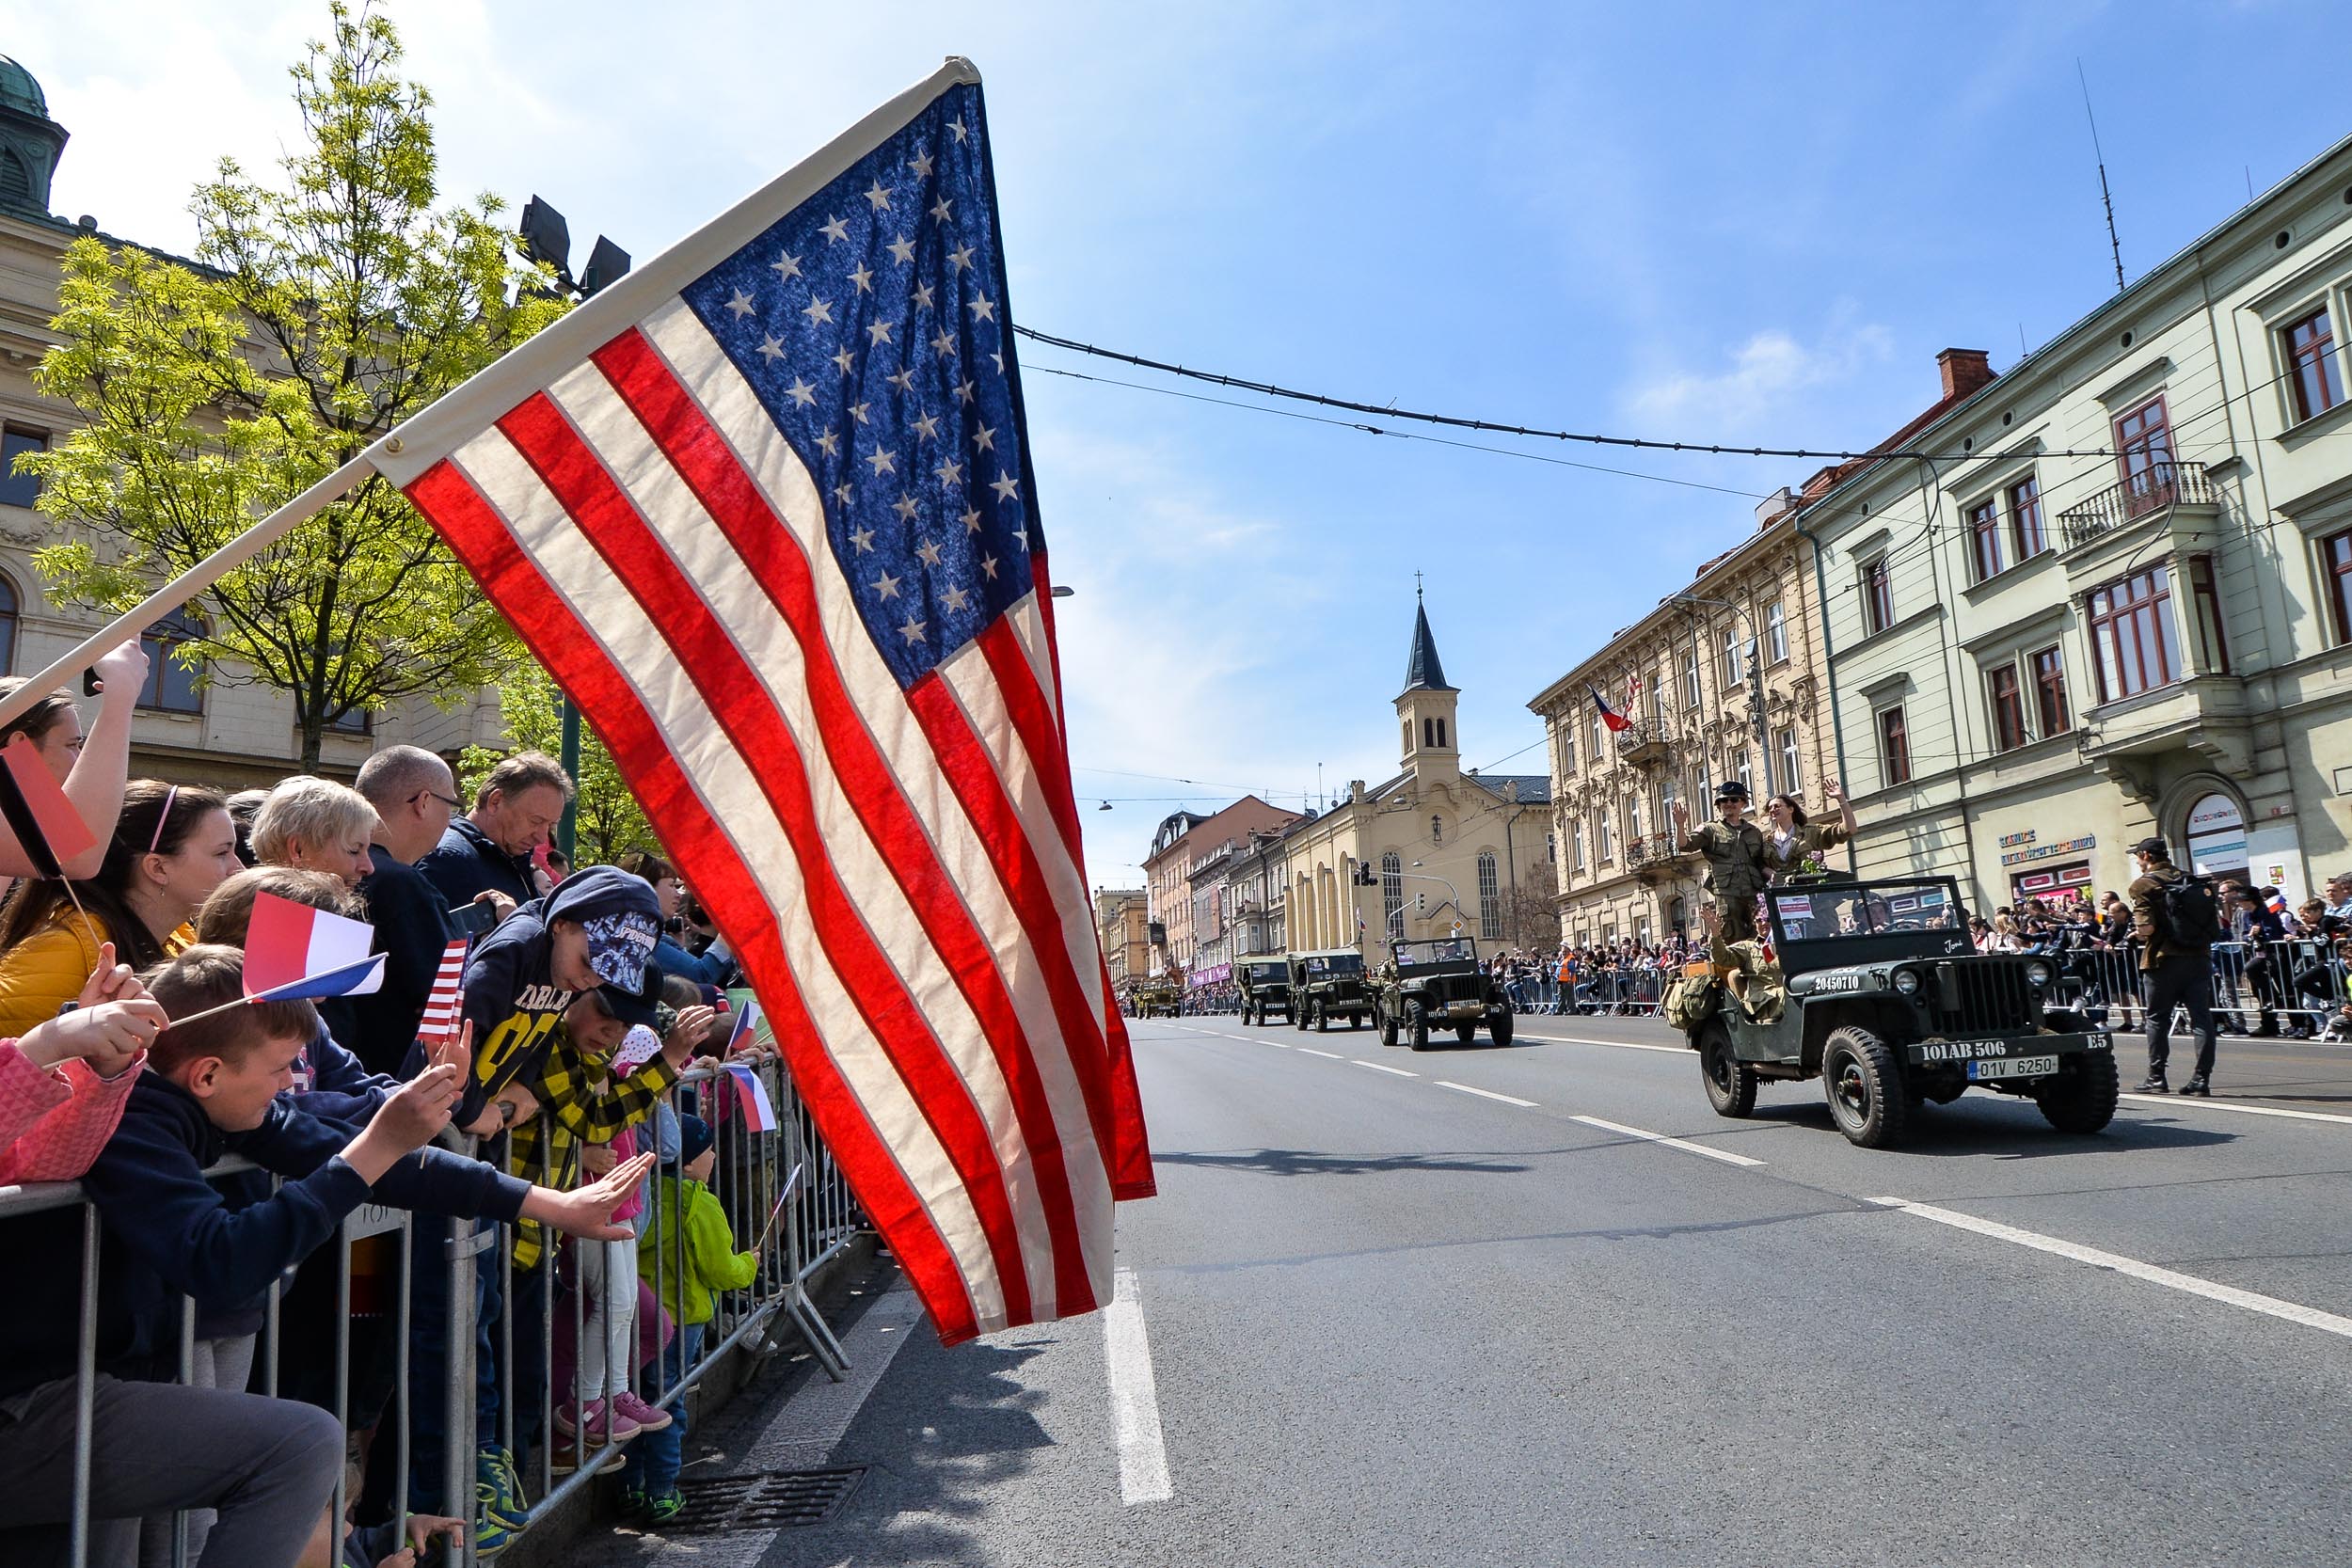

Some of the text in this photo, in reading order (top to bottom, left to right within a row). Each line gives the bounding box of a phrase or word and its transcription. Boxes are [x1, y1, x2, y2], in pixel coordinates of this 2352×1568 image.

[1815, 975, 1859, 990] 20450710
[1922, 1040, 2007, 1061] 101AB 506
[2087, 1034, 2107, 1050] E5
[1980, 1061, 2008, 1077] 01V
[2017, 1058, 2052, 1074] 6250
